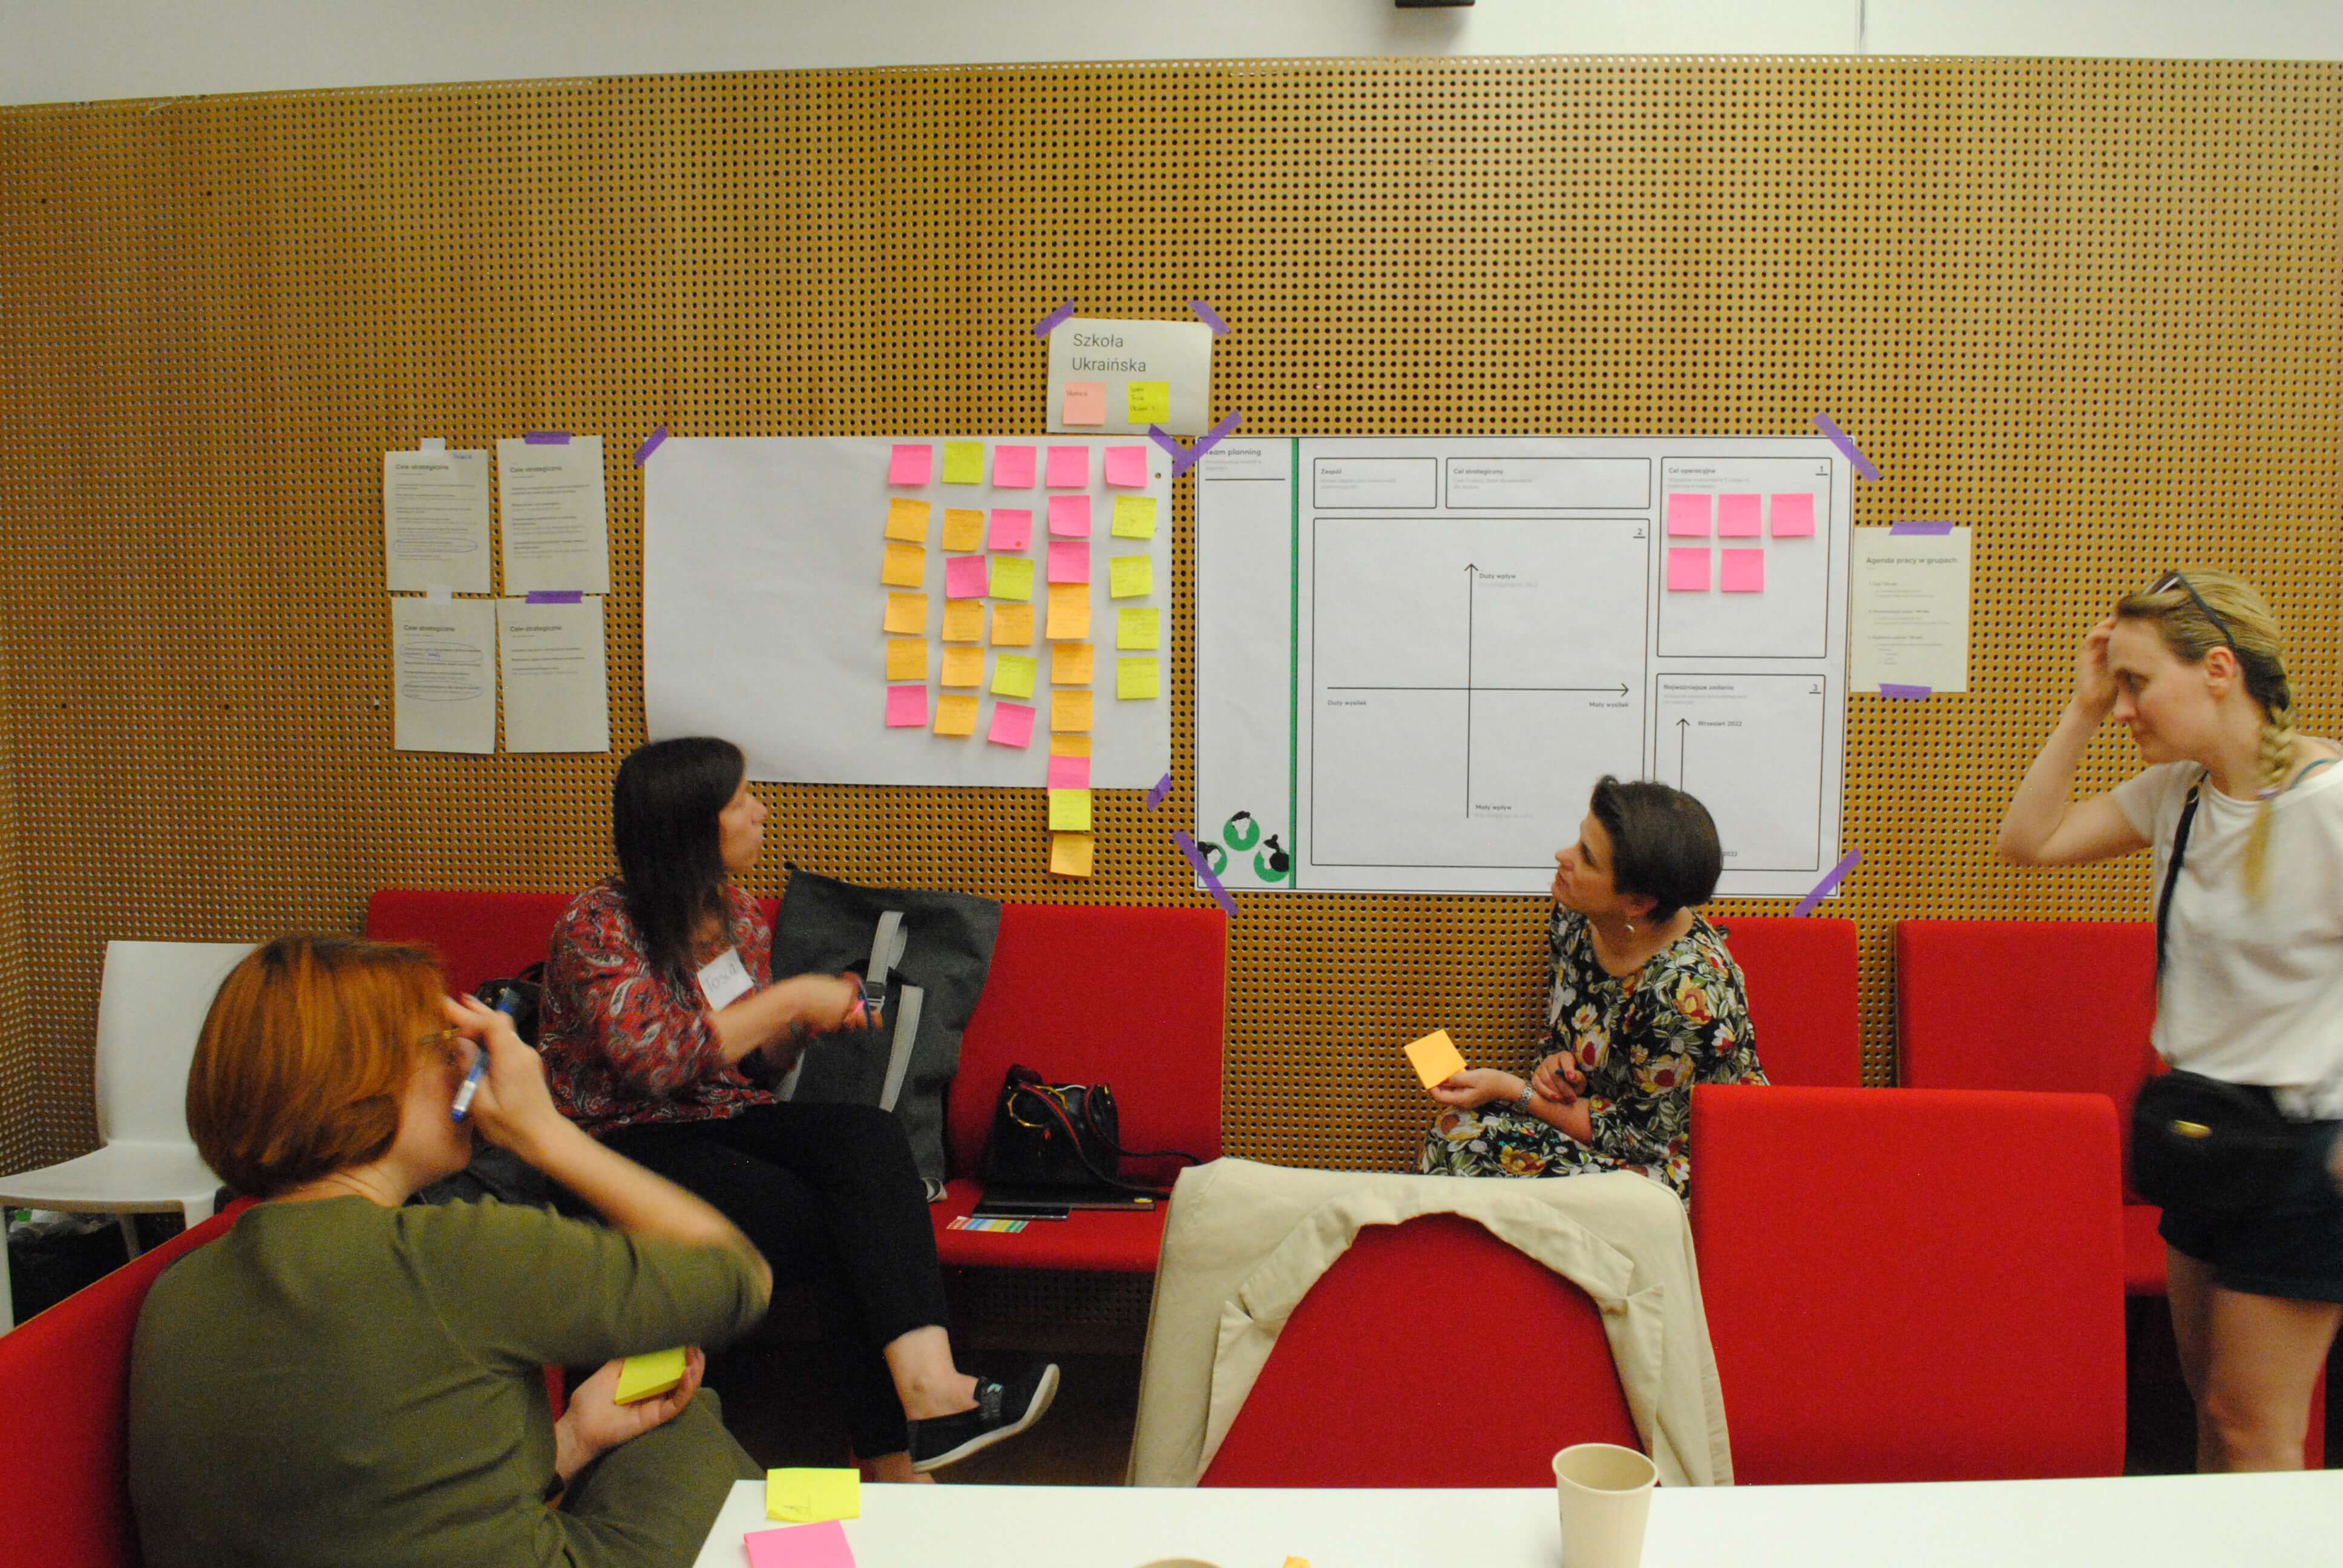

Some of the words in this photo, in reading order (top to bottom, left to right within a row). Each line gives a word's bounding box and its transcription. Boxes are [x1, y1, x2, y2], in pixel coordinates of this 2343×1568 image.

[1073, 333, 1124, 348] Szkoła
[1072, 356, 1147, 372] Ukraińska
[1228, 448, 1262, 457] planning
